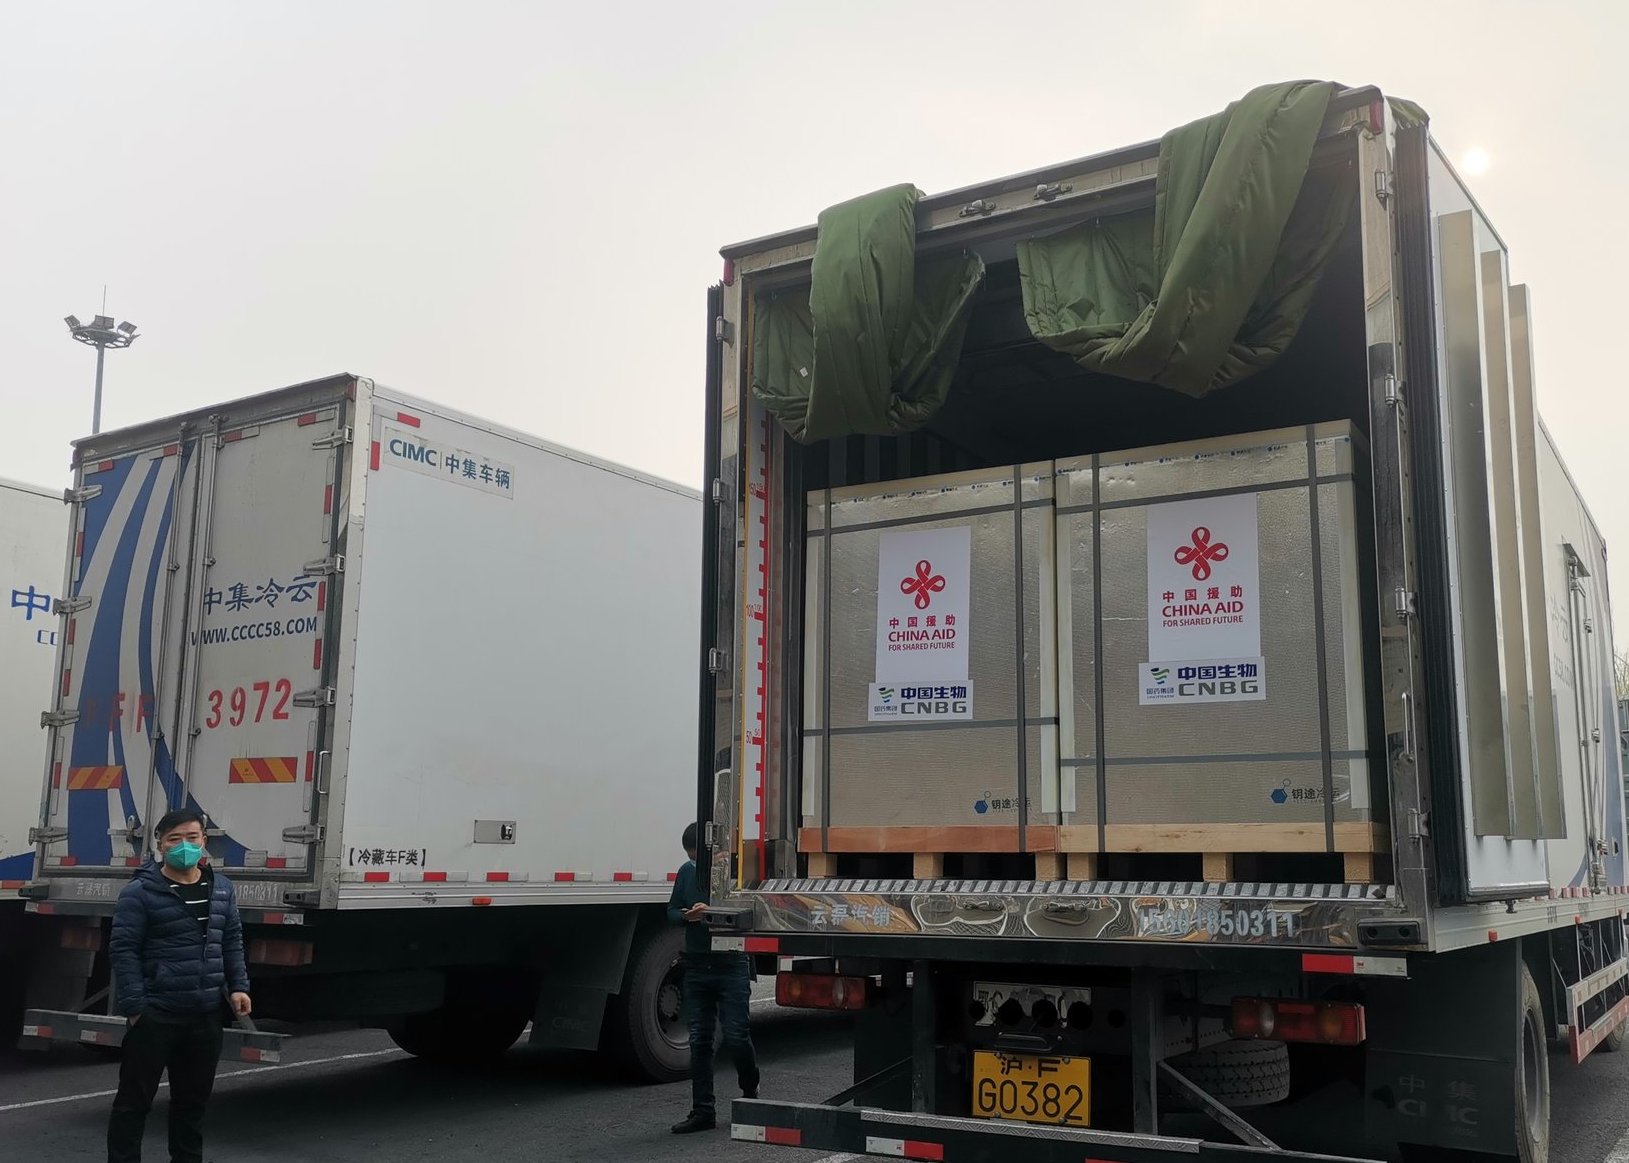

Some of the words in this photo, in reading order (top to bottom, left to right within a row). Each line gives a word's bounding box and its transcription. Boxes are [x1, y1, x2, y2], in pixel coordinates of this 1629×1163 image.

[389, 439, 437, 467] CIMC
[445, 454, 510, 489] 中集车辆
[11, 585, 50, 620] 中
[203, 575, 318, 615] 中集冷云
[1163, 585, 1243, 604] 中国援助
[1162, 602, 1212, 618] CHINA
[1215, 601, 1244, 614] AID
[889, 614, 956, 629] 中国援助
[1163, 618, 1178, 627] FOR
[1179, 617, 1211, 627] SHARED
[1212, 615, 1244, 625] FUTURE
[888, 630, 930, 642] CHINA
[932, 628, 956, 640] AID
[888, 643, 901, 651] FOR
[902, 642, 929, 651] SHARED
[929, 641, 955, 650] FUTURE
[1177, 664, 1258, 681] 中国生物
[901, 686, 967, 700] 中国生物
[1178, 680, 1259, 697] CNBG
[206, 678, 292, 729] 3972
[901, 701, 967, 714] CNBG
[978, 1077, 1083, 1121] G0382
